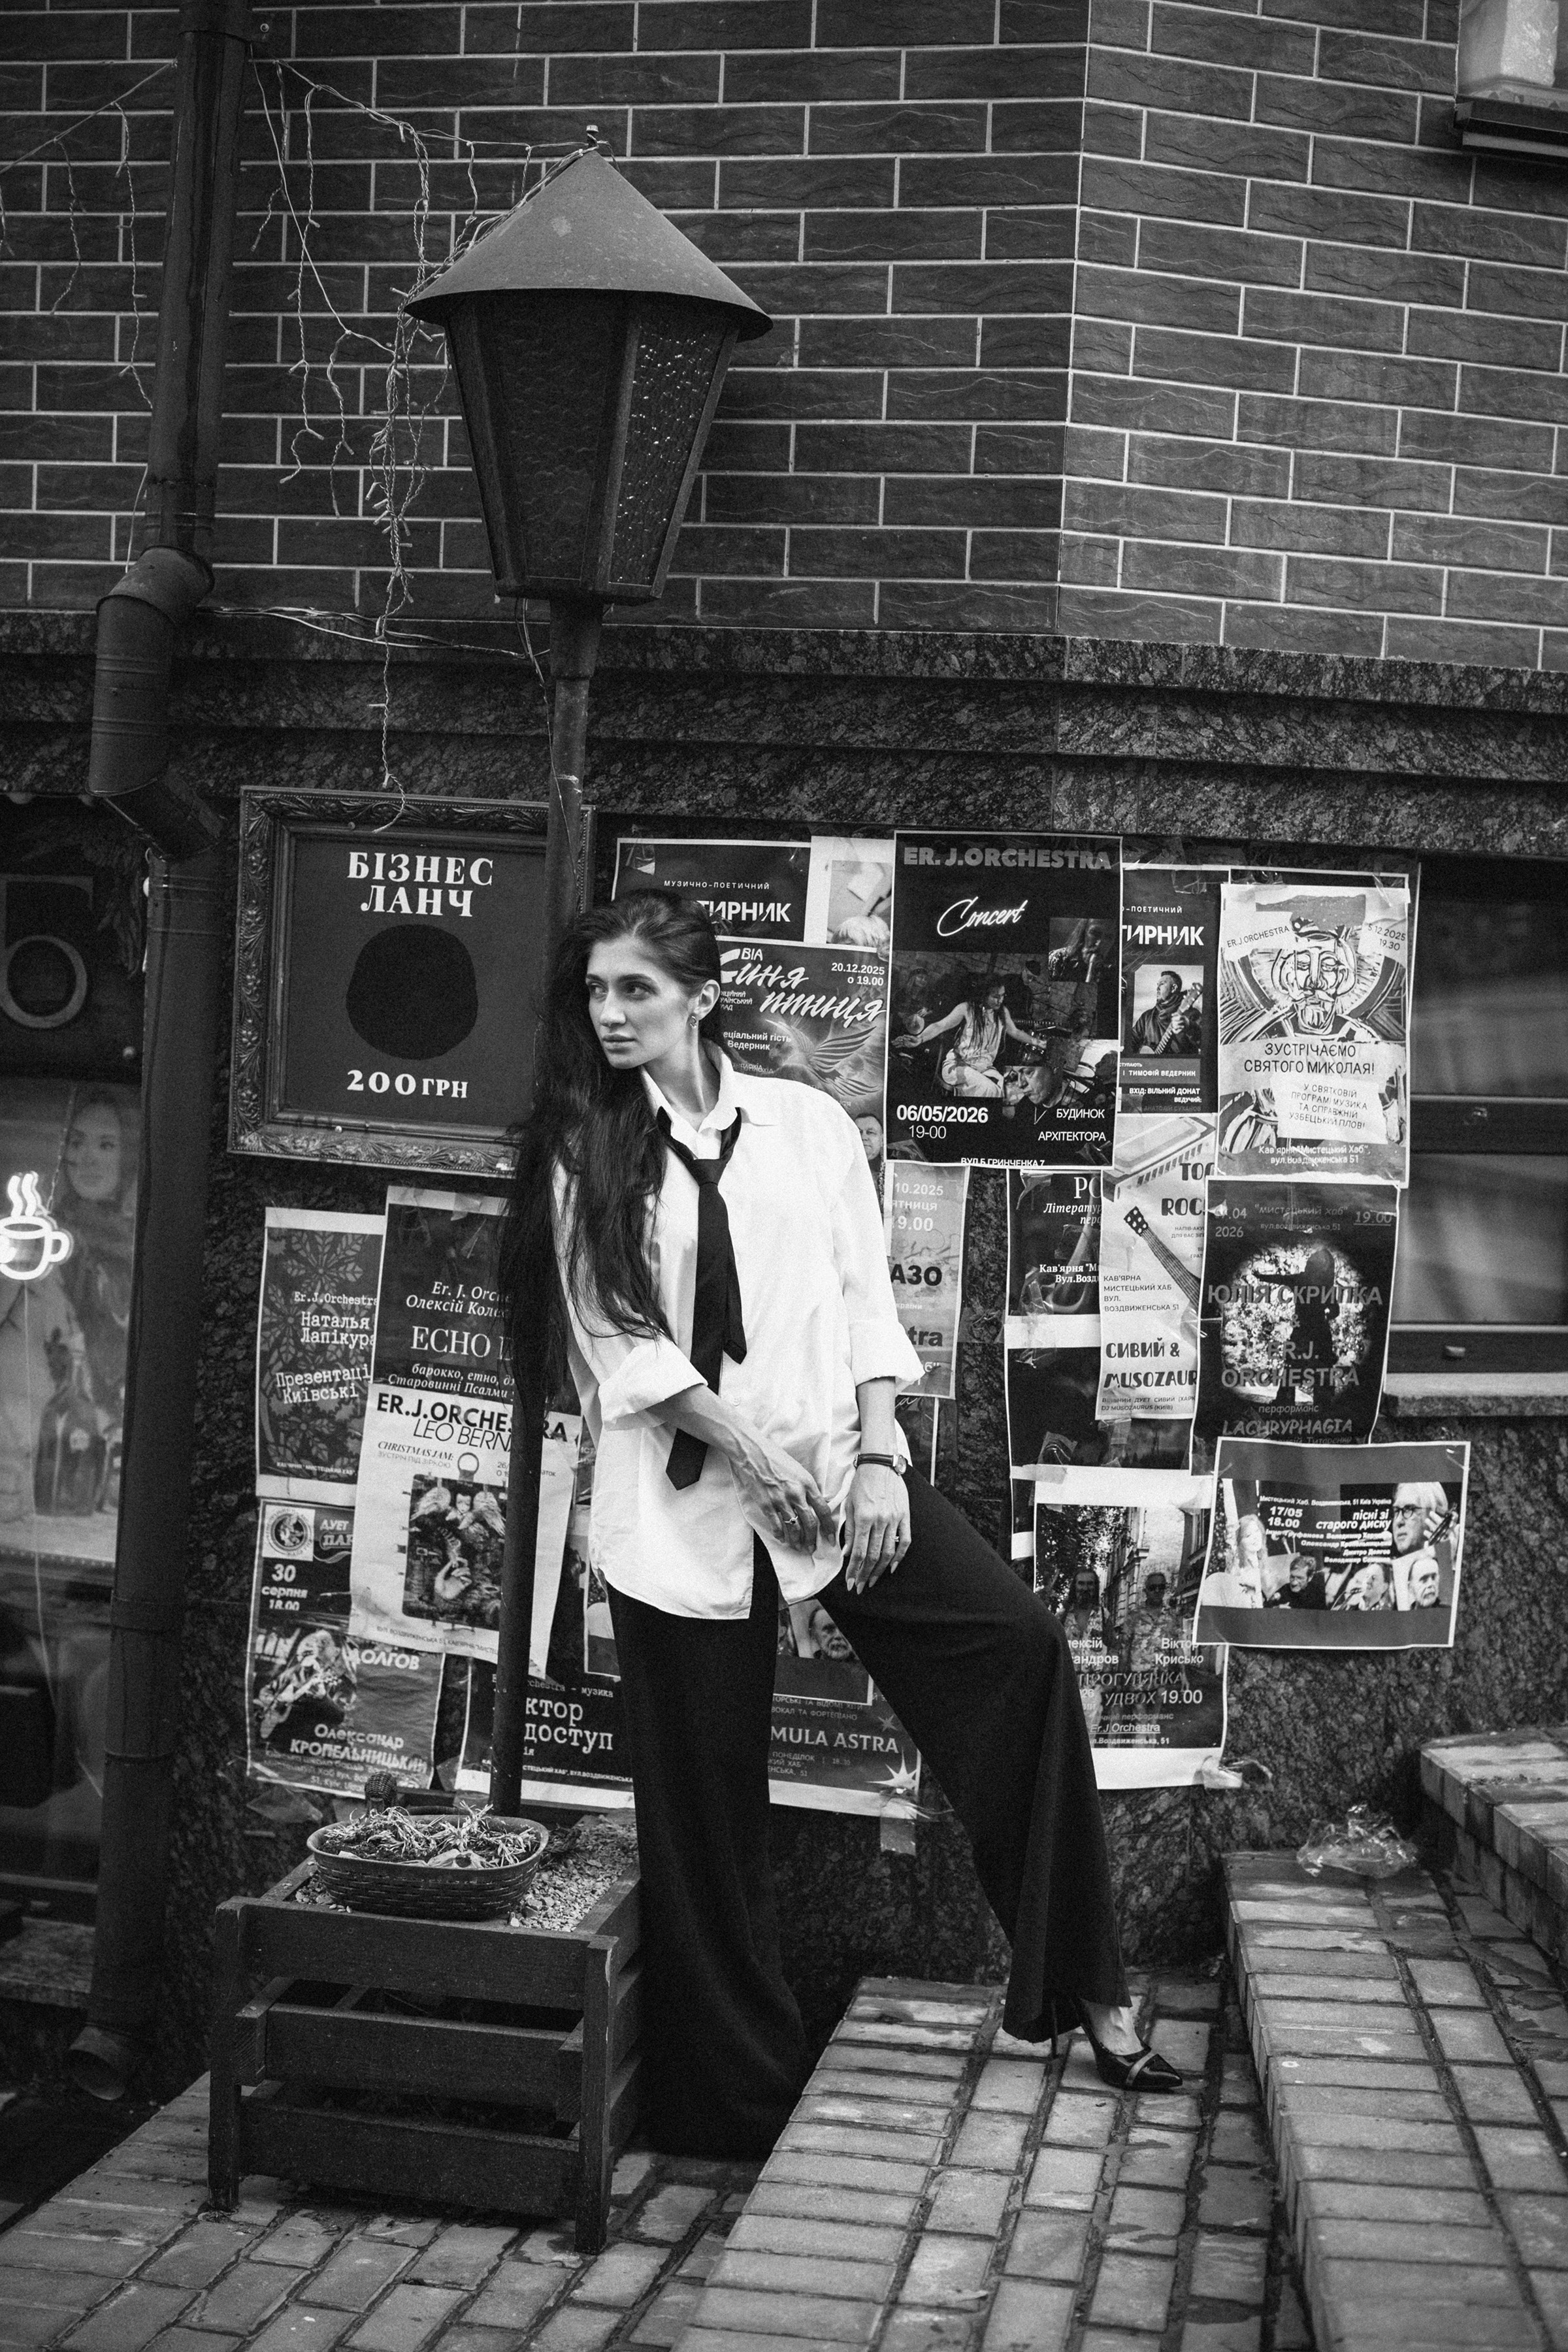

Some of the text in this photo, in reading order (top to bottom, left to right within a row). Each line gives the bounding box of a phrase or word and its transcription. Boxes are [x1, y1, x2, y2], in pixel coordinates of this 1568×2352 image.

[347, 851, 493, 886] БІЗНЕС
[361, 885, 473, 917] ЛАНЧ
[937, 896, 1028, 936] Concert
[1379, 938, 1401, 951] 19.30
[831, 962, 885, 975] 20.12.2025
[857, 975, 884, 986] 19.00
[728, 1040, 770, 1051] Ведерник
[770, 1034, 792, 1043] гість
[1264, 1043, 1356, 1057] ЗУСТРІЧАЄМО
[1244, 1060, 1375, 1075] СВЯТОГО МИКОЛАЯ!
[1312, 1084, 1357, 1098] СВЯТКОВІЙ
[1291, 1092, 1367, 1110] ПРОГРАМІ МУЗИКА
[896, 1104, 988, 1123] 06/05/2026
[1056, 1108, 1105, 1120] БУДИНОК
[1311, 1105, 1358, 1119] СПРАВЖНІЙ
[909, 1124, 947, 1139] 19-00
[1037, 1131, 1106, 1142] АРХІТЕКТОРА
[1161, 1198, 1205, 1216] ROC
[1215, 1226, 1244, 1237] 2026
[1039, 1264, 1084, 1274] Кав'ярня
[1103, 1284, 1155, 1292] МИСТЕЦЬКИЙ
[1209, 1284, 1383, 1305] ЮЛІЯ СКРИПКА
[406, 1294, 464, 1313] Олексій
[1104, 1304, 1171, 1313] ВОЗДВИЖЕНСЬКА
[301, 1311, 370, 1330] Наталья
[410, 1326, 491, 1358] ECHO
[1105, 1337, 1180, 1358] СИВИЙ &
[412, 1363, 464, 1380] барокко,
[468, 1371, 499, 1386] етно,
[1222, 1368, 1360, 1388] ORCHESTRA
[388, 1373, 461, 1392] Старовинні
[464, 1382, 508, 1398] Псалми
[282, 1382, 359, 1405] Київські
[1258, 1405, 1319, 1416] перформанс
[413, 1418, 512, 1452] LEO BERN
[378, 1441, 432, 1457] CHRISTMAS
[1269, 1506, 1303, 1518] 17/05
[1352, 1509, 1390, 1520] пісні зі
[319, 1519, 350, 1531] ДУЕТ
[1267, 1517, 1300, 1528] 18.00
[1316, 1520, 1392, 1532] старого диску
[271, 1563, 297, 1582] 30
[261, 1586, 308, 1599] серпня
[269, 1599, 301, 1611] 18.00
[1155, 1654, 1204, 1667] Крисько
[581, 1686, 613, 1697] музика
[1105, 1691, 1156, 1707] УДВОХ
[1161, 1690, 1203, 1704] 19.00
[314, 1723, 404, 1750] Олександр
[524, 1723, 613, 1754] доступ
[833, 1732, 899, 1754] ASTRA
[289, 1739, 428, 1774] КРОПЕЛЬНИЦЬКИЙ
